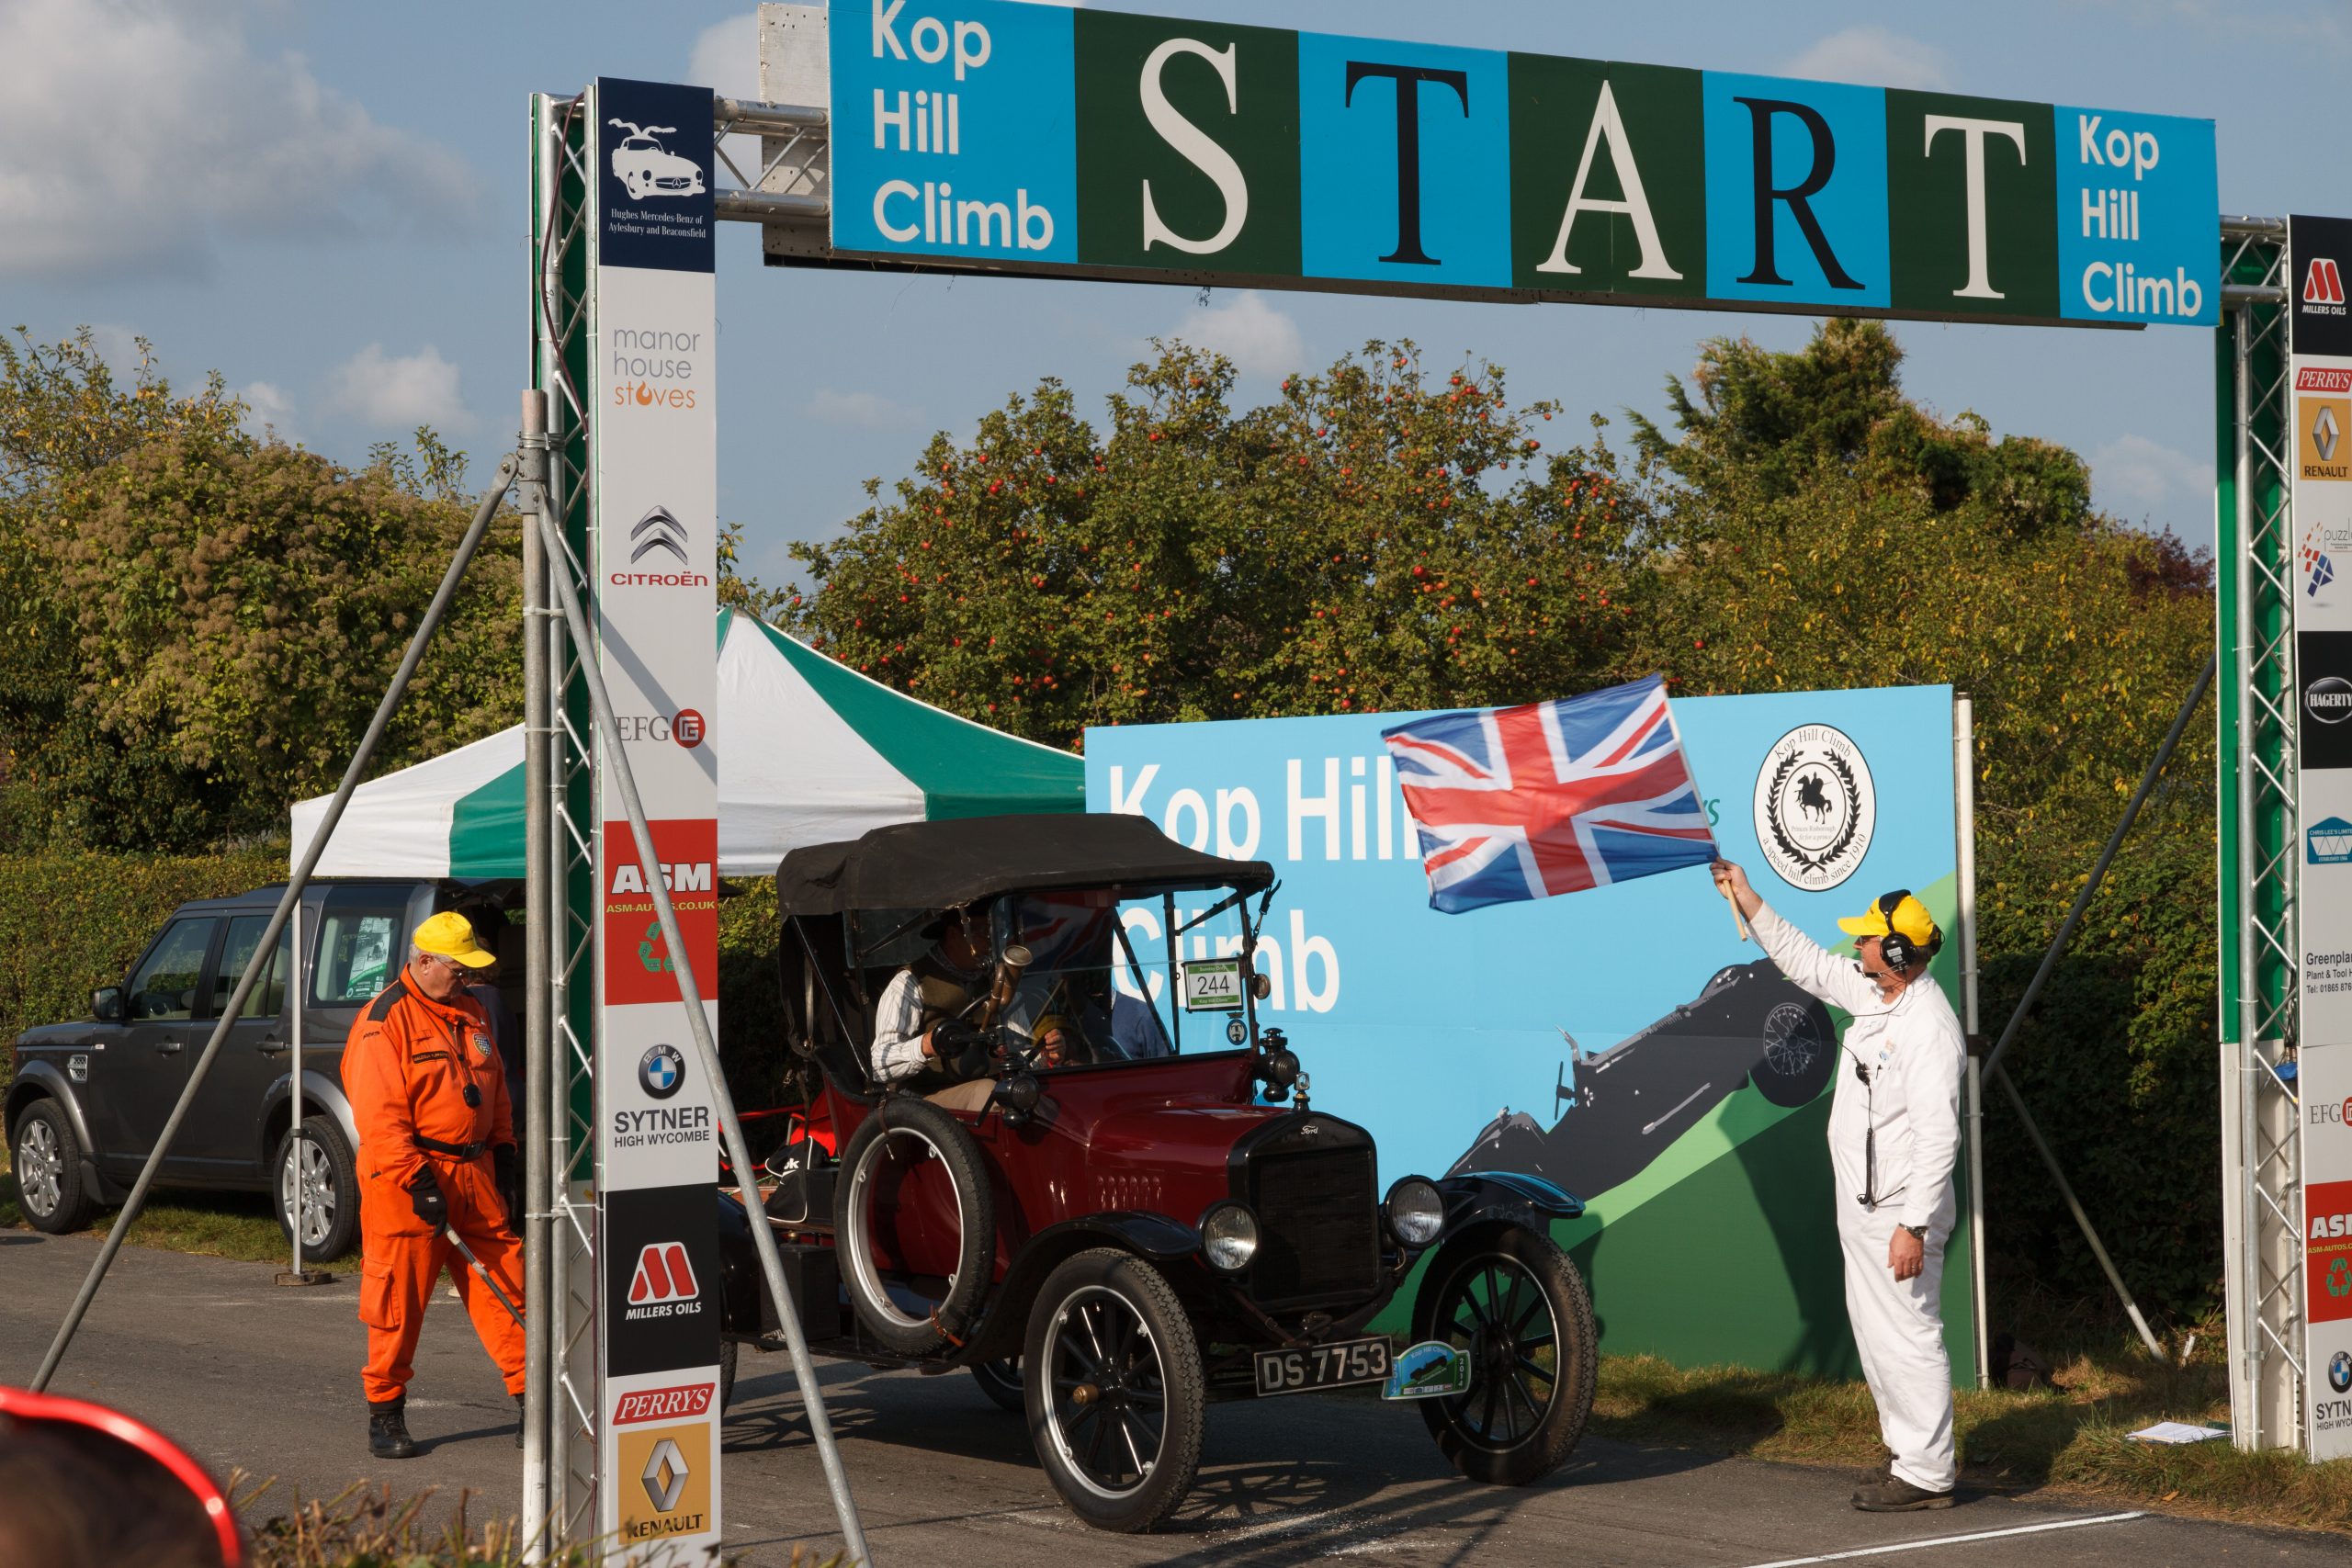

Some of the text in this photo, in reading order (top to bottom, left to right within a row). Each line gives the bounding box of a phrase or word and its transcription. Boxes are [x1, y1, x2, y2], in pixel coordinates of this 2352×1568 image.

[872, 0, 991, 81] Kop
[873, 87, 959, 155] Hill
[2079, 114, 2159, 180] Kop
[1140, 37, 2027, 299] START
[611, 209, 703, 224] Hughes Mercedes-Benz of
[873, 179, 1055, 251] Climb
[2082, 188, 2139, 241] Hill
[608, 222, 707, 238] Aylesbury and Beaconsfield
[2083, 261, 2203, 318] Climb
[2302, 304, 2346, 316] MILLERS OILS
[614, 329, 701, 352] manor
[614, 351, 692, 378] house
[2299, 370, 2351, 389] PERRYS
[614, 380, 695, 409] stoves
[2304, 466, 2348, 478] RENAULT
[2310, 694, 2352, 706] HAGERTY
[615, 716, 670, 741] EFG
[1774, 728, 1851, 760] Kop Hill Climb
[1110, 764, 1261, 862] Kop
[1763, 833, 1867, 886] a speed hill climb since 1910
[605, 901, 716, 914] ASM-AUS.CO.UK
[2306, 951, 2352, 967] Greenpla
[1197, 975, 1230, 995] 244
[2306, 970, 2324, 980] Plant
[2325, 969, 2331, 978] &
[2333, 968, 2347, 978] Tool
[2306, 982, 2352, 994] Tel: 01865 876
[643, 1045, 682, 1064] BMW
[615, 1106, 709, 1134] SYTNER
[2310, 1103, 2341, 1124] EFG
[614, 1130, 709, 1148] HIGH WYCOMBE
[1301, 1125, 1318, 1134] Ford
[626, 1302, 702, 1321] MILLERS OILS
[1262, 1353, 1305, 1390] DS
[1312, 1343, 1386, 1383] 7753
[617, 1388, 710, 1420] PERRYS
[2316, 1417, 2352, 1432] HIGH WYC
[628, 1513, 704, 1539] RENAULT
